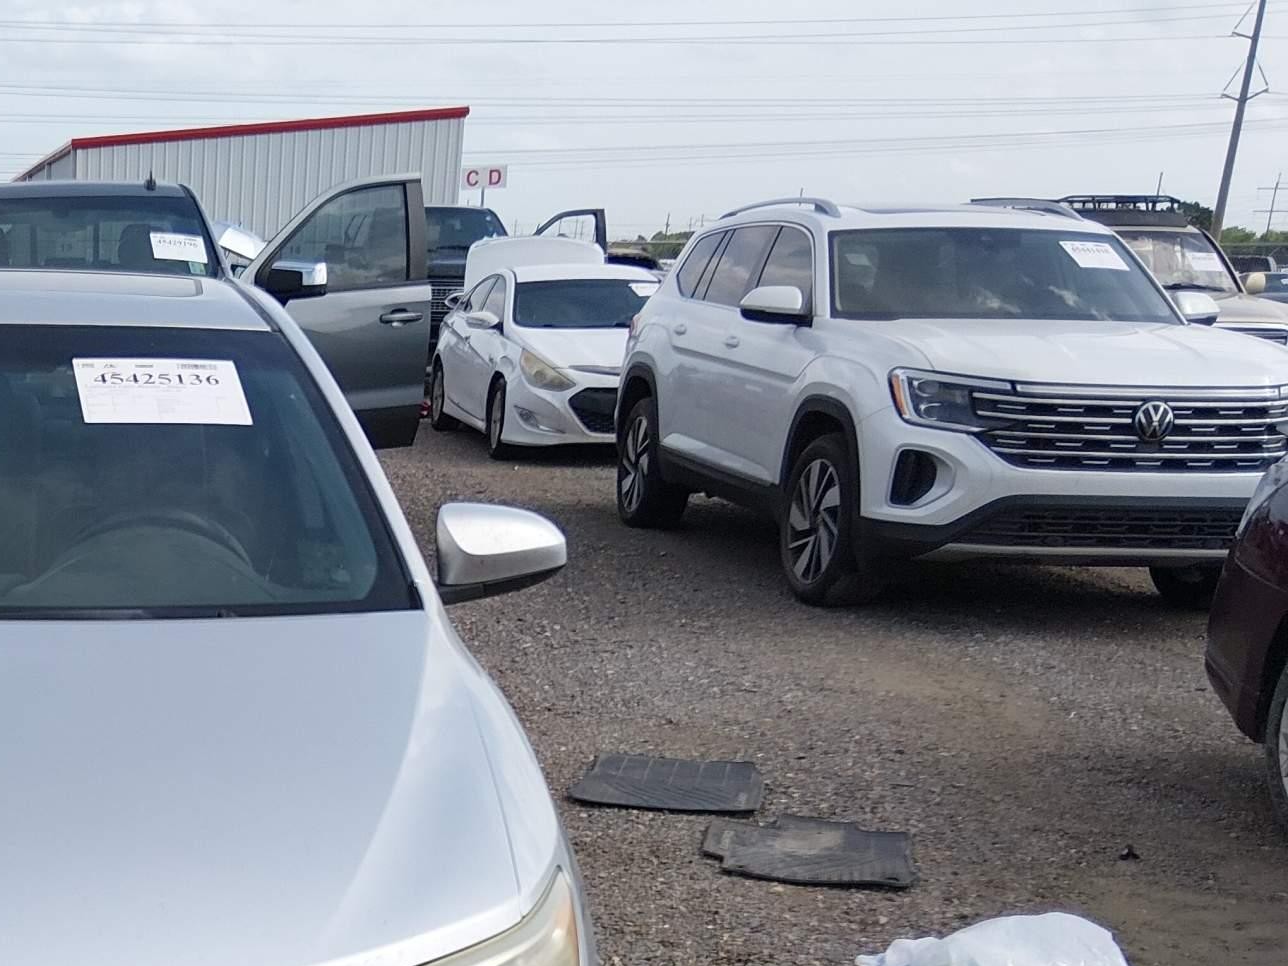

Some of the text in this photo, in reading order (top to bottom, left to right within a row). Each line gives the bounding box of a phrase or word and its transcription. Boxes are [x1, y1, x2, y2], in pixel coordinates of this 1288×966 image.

[466, 169, 501, 186] C D
[94, 373, 220, 386] 45425136
